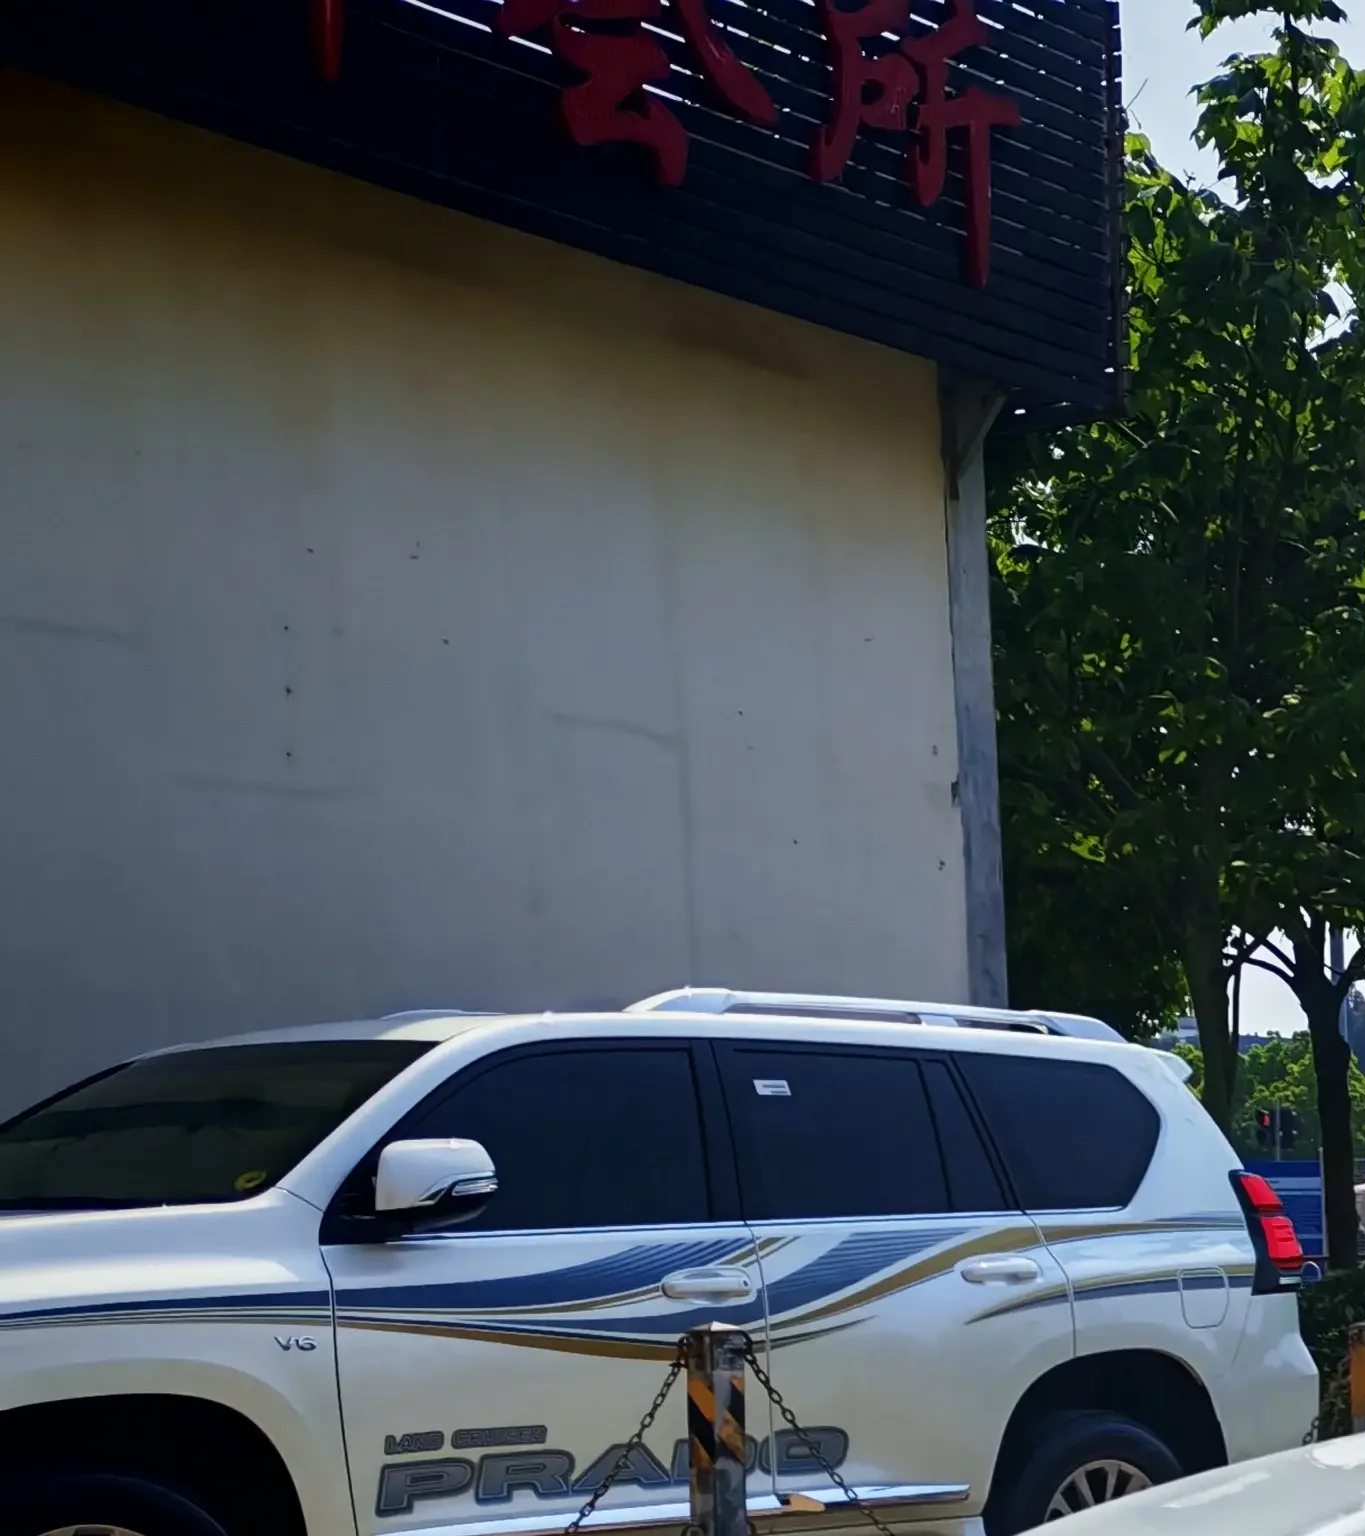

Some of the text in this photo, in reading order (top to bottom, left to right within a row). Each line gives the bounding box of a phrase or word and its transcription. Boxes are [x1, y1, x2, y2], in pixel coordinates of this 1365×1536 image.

[273, 1335, 317, 1352] V6
[384, 1424, 548, 1455] LAND CRUISER
